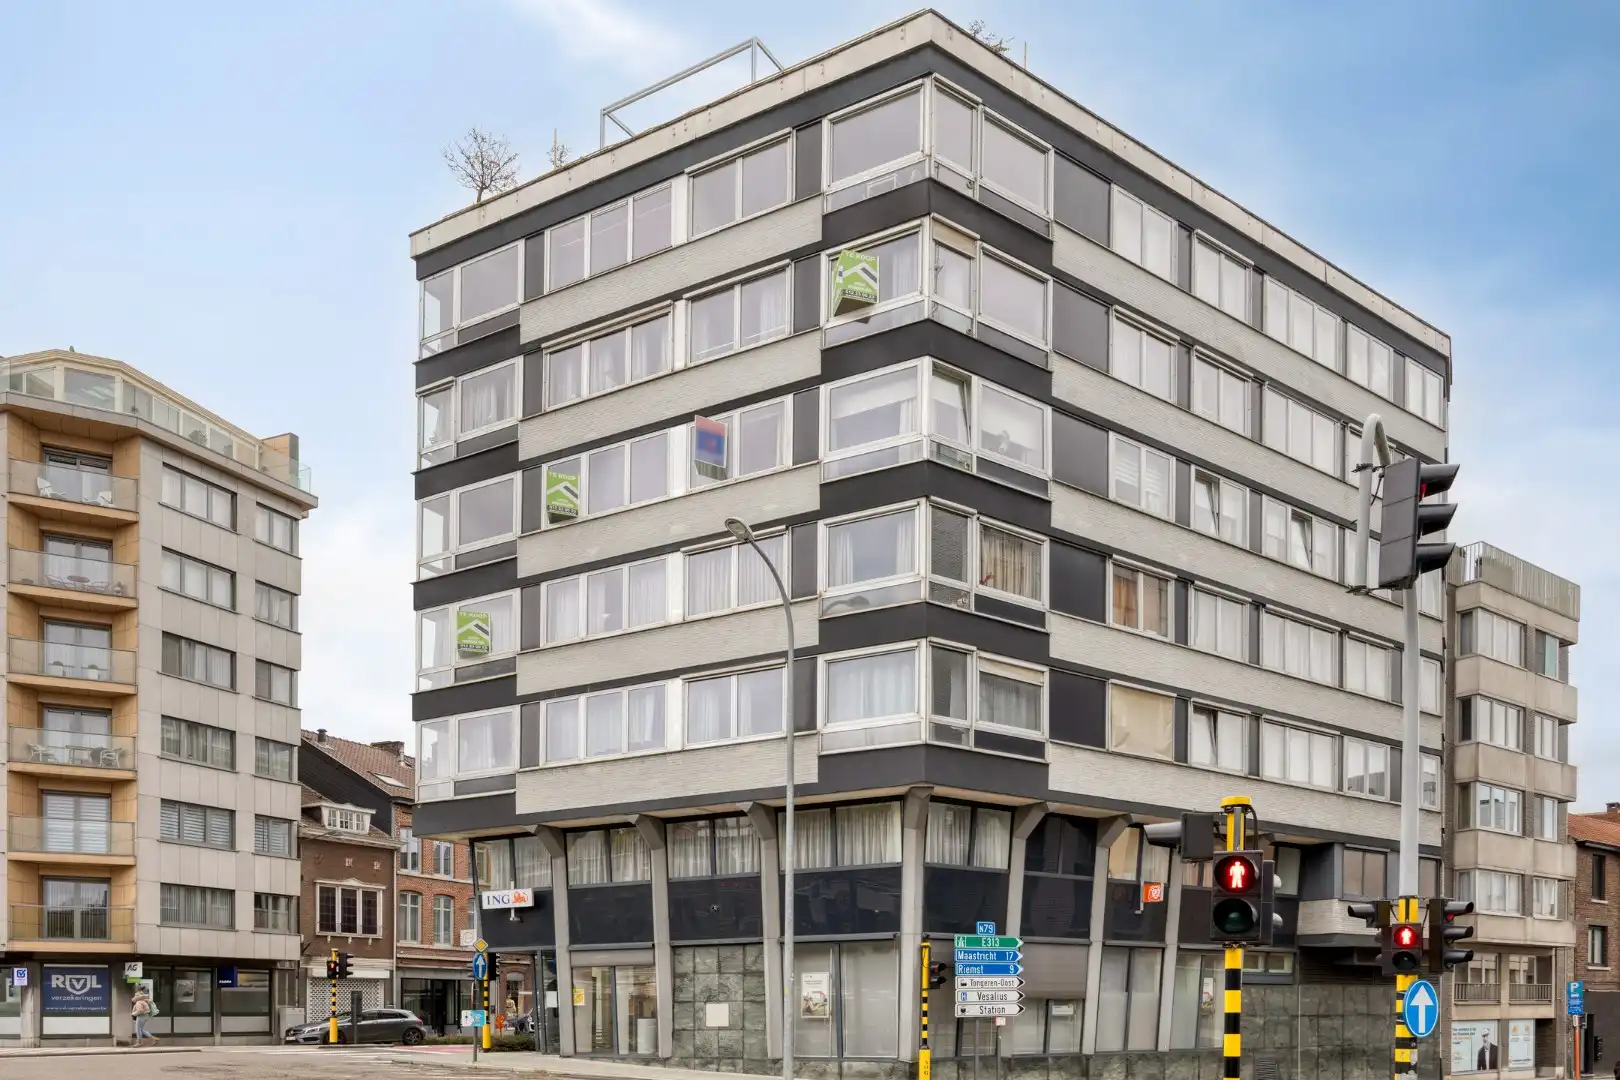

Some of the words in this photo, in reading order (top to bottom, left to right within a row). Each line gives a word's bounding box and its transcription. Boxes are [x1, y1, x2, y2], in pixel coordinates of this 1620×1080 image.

[487, 894, 511, 906] ING
[979, 924, 994, 934] N79
[982, 938, 1000, 947] E313
[957, 951, 997, 961] Maastricht
[1006, 952, 1014, 960] 17
[958, 964, 984, 974] Riemst
[1009, 965, 1015, 974] 9
[970, 979, 1015, 988] Tongeren-Oost
[1570, 982, 1580, 993] P
[51, 995, 102, 1003] verzekeringen
[976, 992, 1008, 1001] Vesalius
[979, 1005, 1006, 1014] Station
